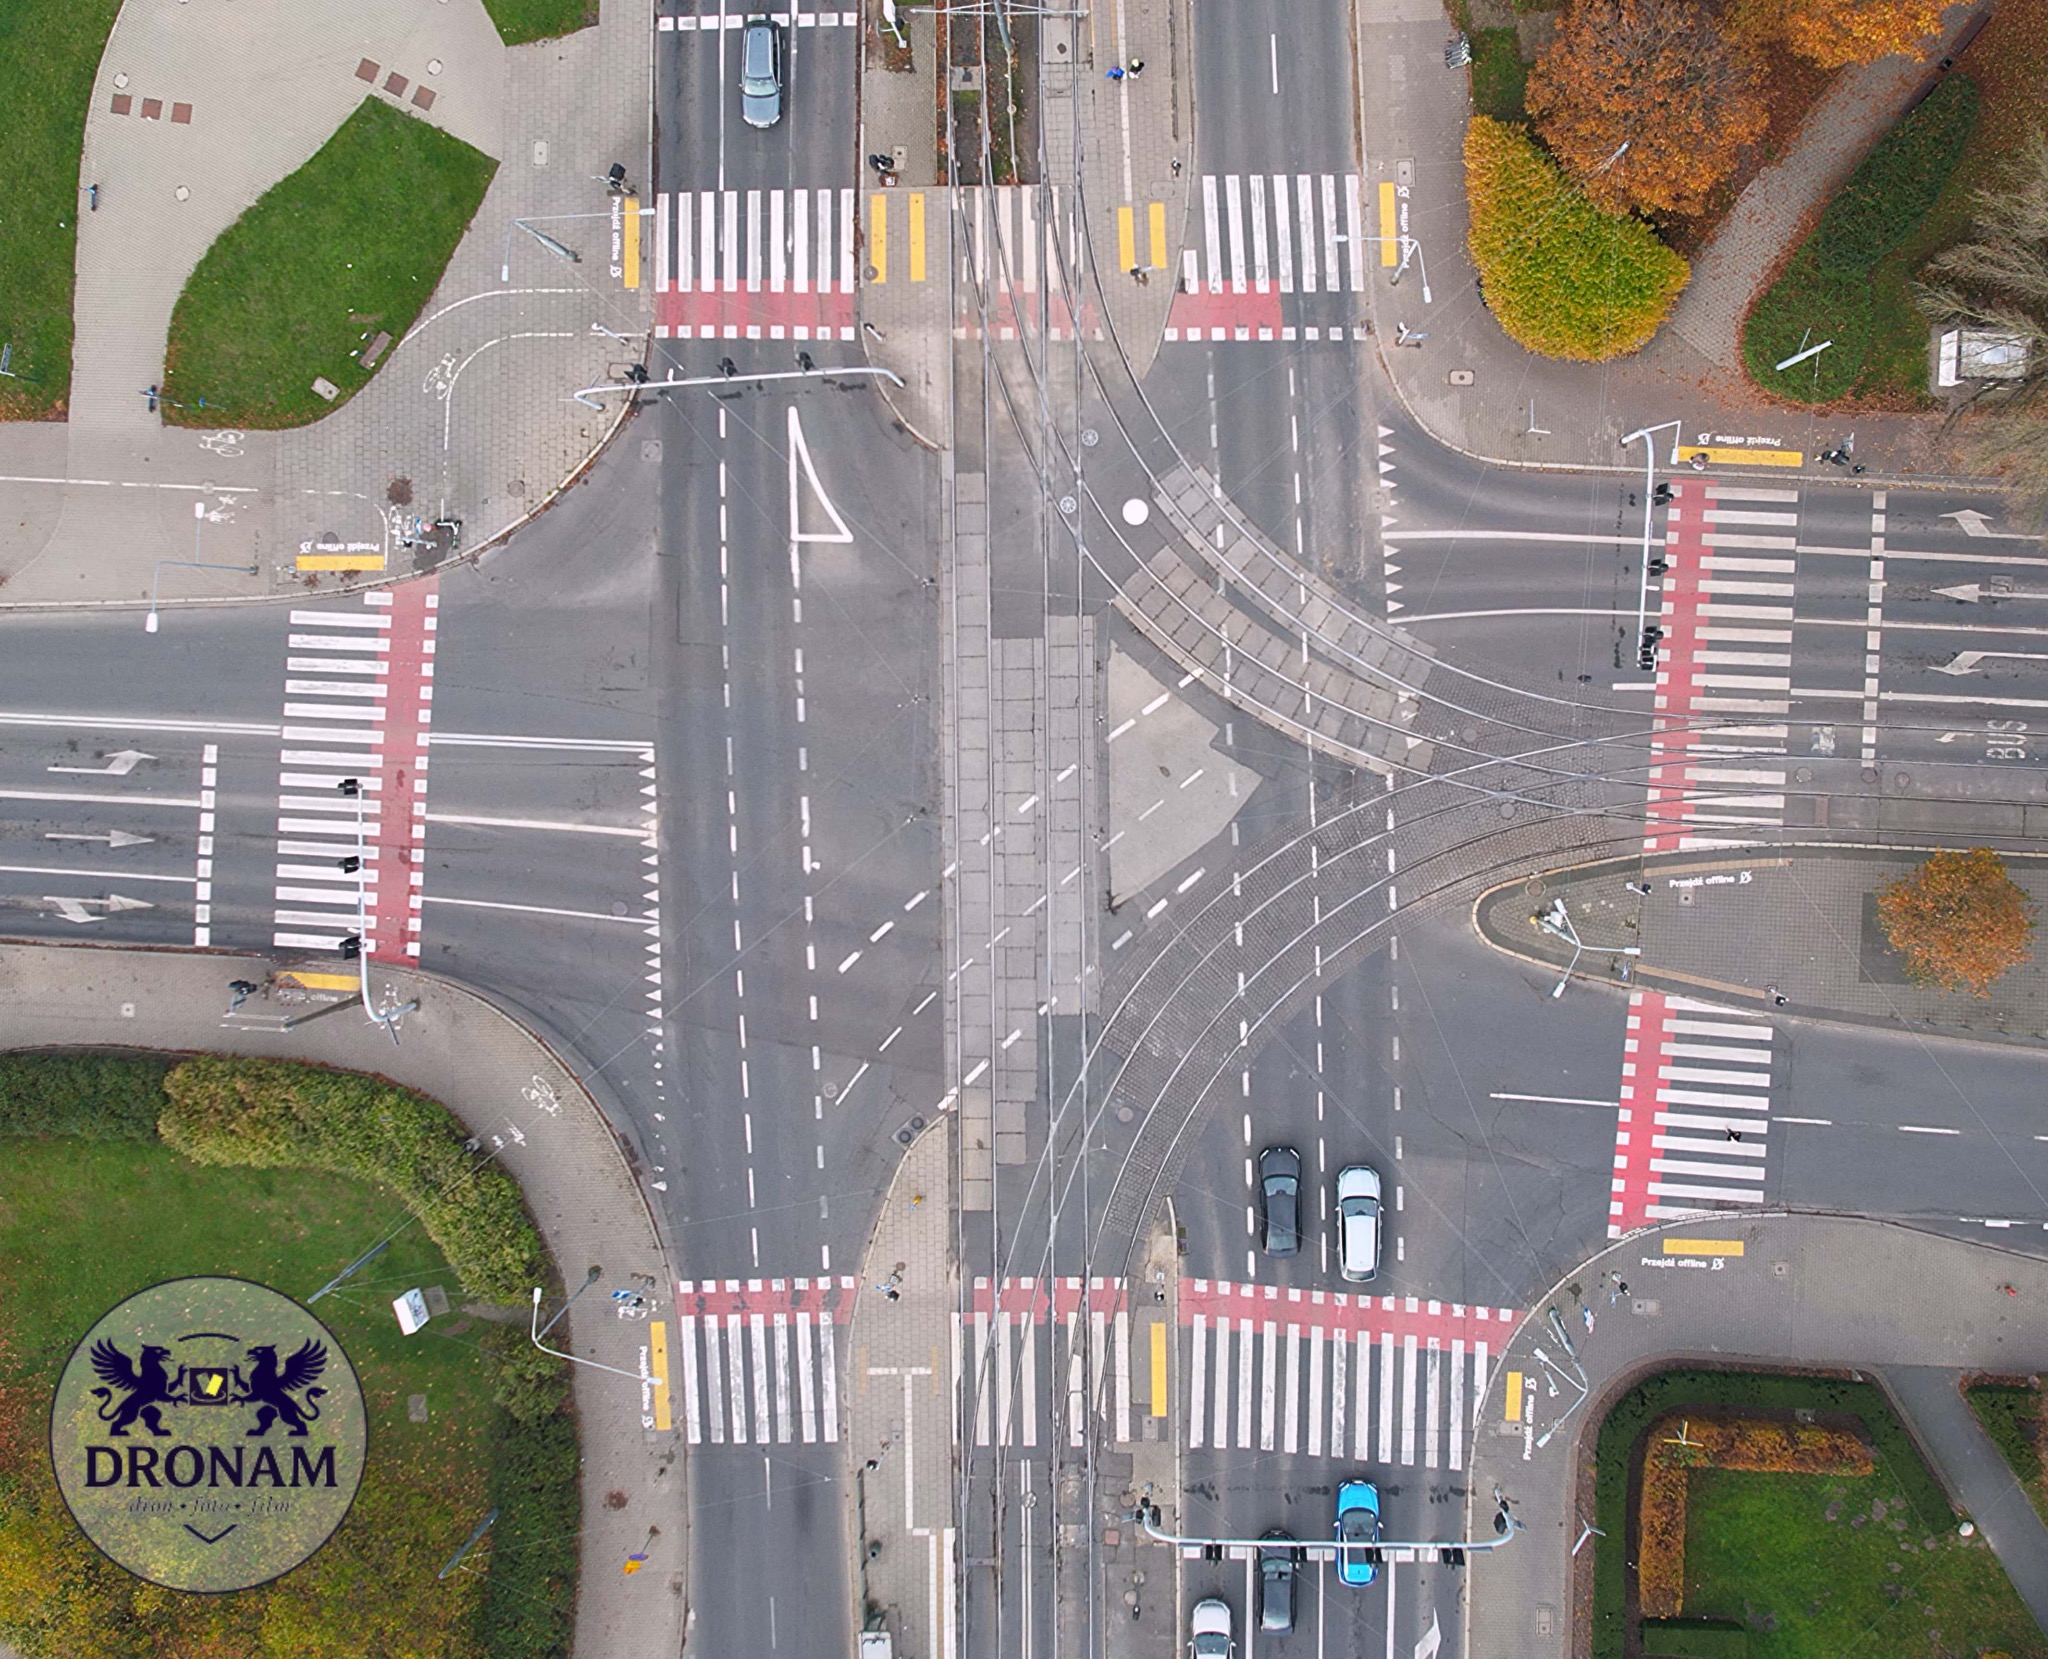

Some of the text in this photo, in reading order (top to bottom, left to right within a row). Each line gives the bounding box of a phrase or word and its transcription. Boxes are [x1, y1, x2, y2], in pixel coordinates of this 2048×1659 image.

[1400, 202, 1409, 233] offline
[611, 232, 621, 261] offline
[1714, 434, 1781, 447] Przejdź offline
[316, 541, 380, 553] Przejdź offline
[1986, 719, 2028, 760] BUS
[1669, 875, 1736, 888] Przejdź offline
[1641, 1257, 1708, 1269] Przejdź offline
[1522, 1394, 1535, 1461] Przejdź offline
